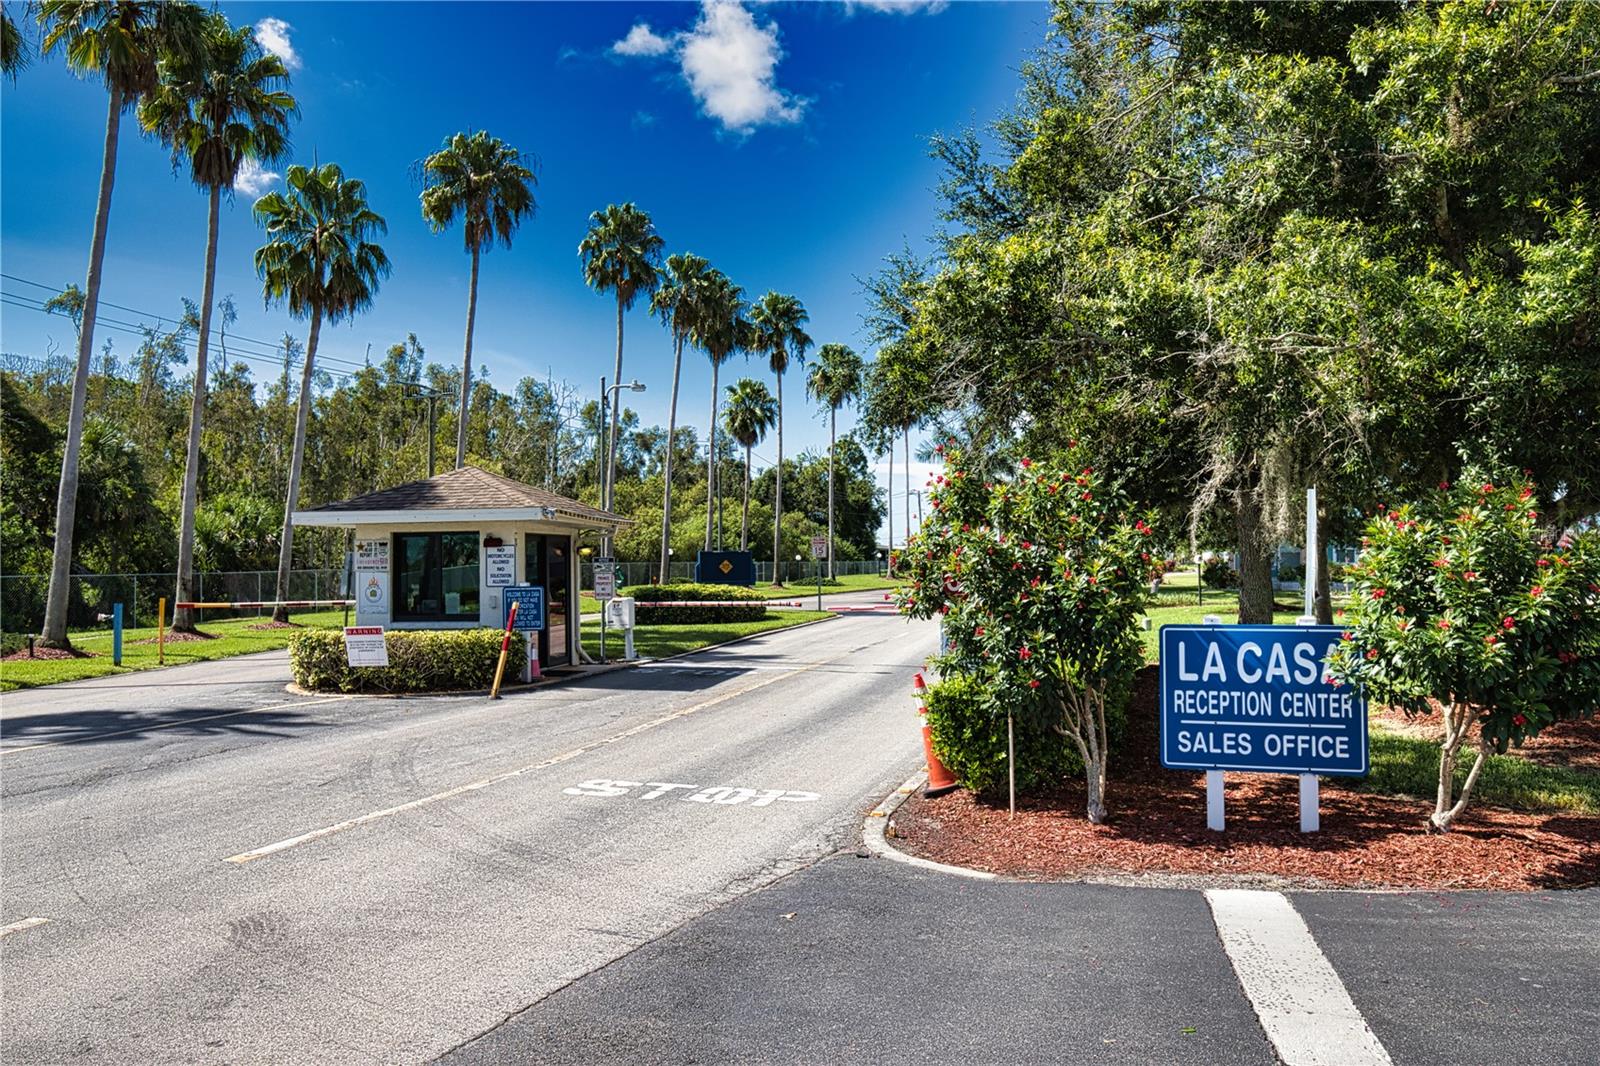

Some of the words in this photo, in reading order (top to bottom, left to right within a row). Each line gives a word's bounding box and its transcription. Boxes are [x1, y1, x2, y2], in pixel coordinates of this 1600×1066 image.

[1178, 641, 1227, 682] LA
[1174, 690, 1272, 716] RECEPTION
[1280, 692, 1353, 719] CENTER
[1178, 731, 1252, 755] SALES
[1264, 734, 1350, 759] OFFICE
[563, 779, 822, 807] STOP
